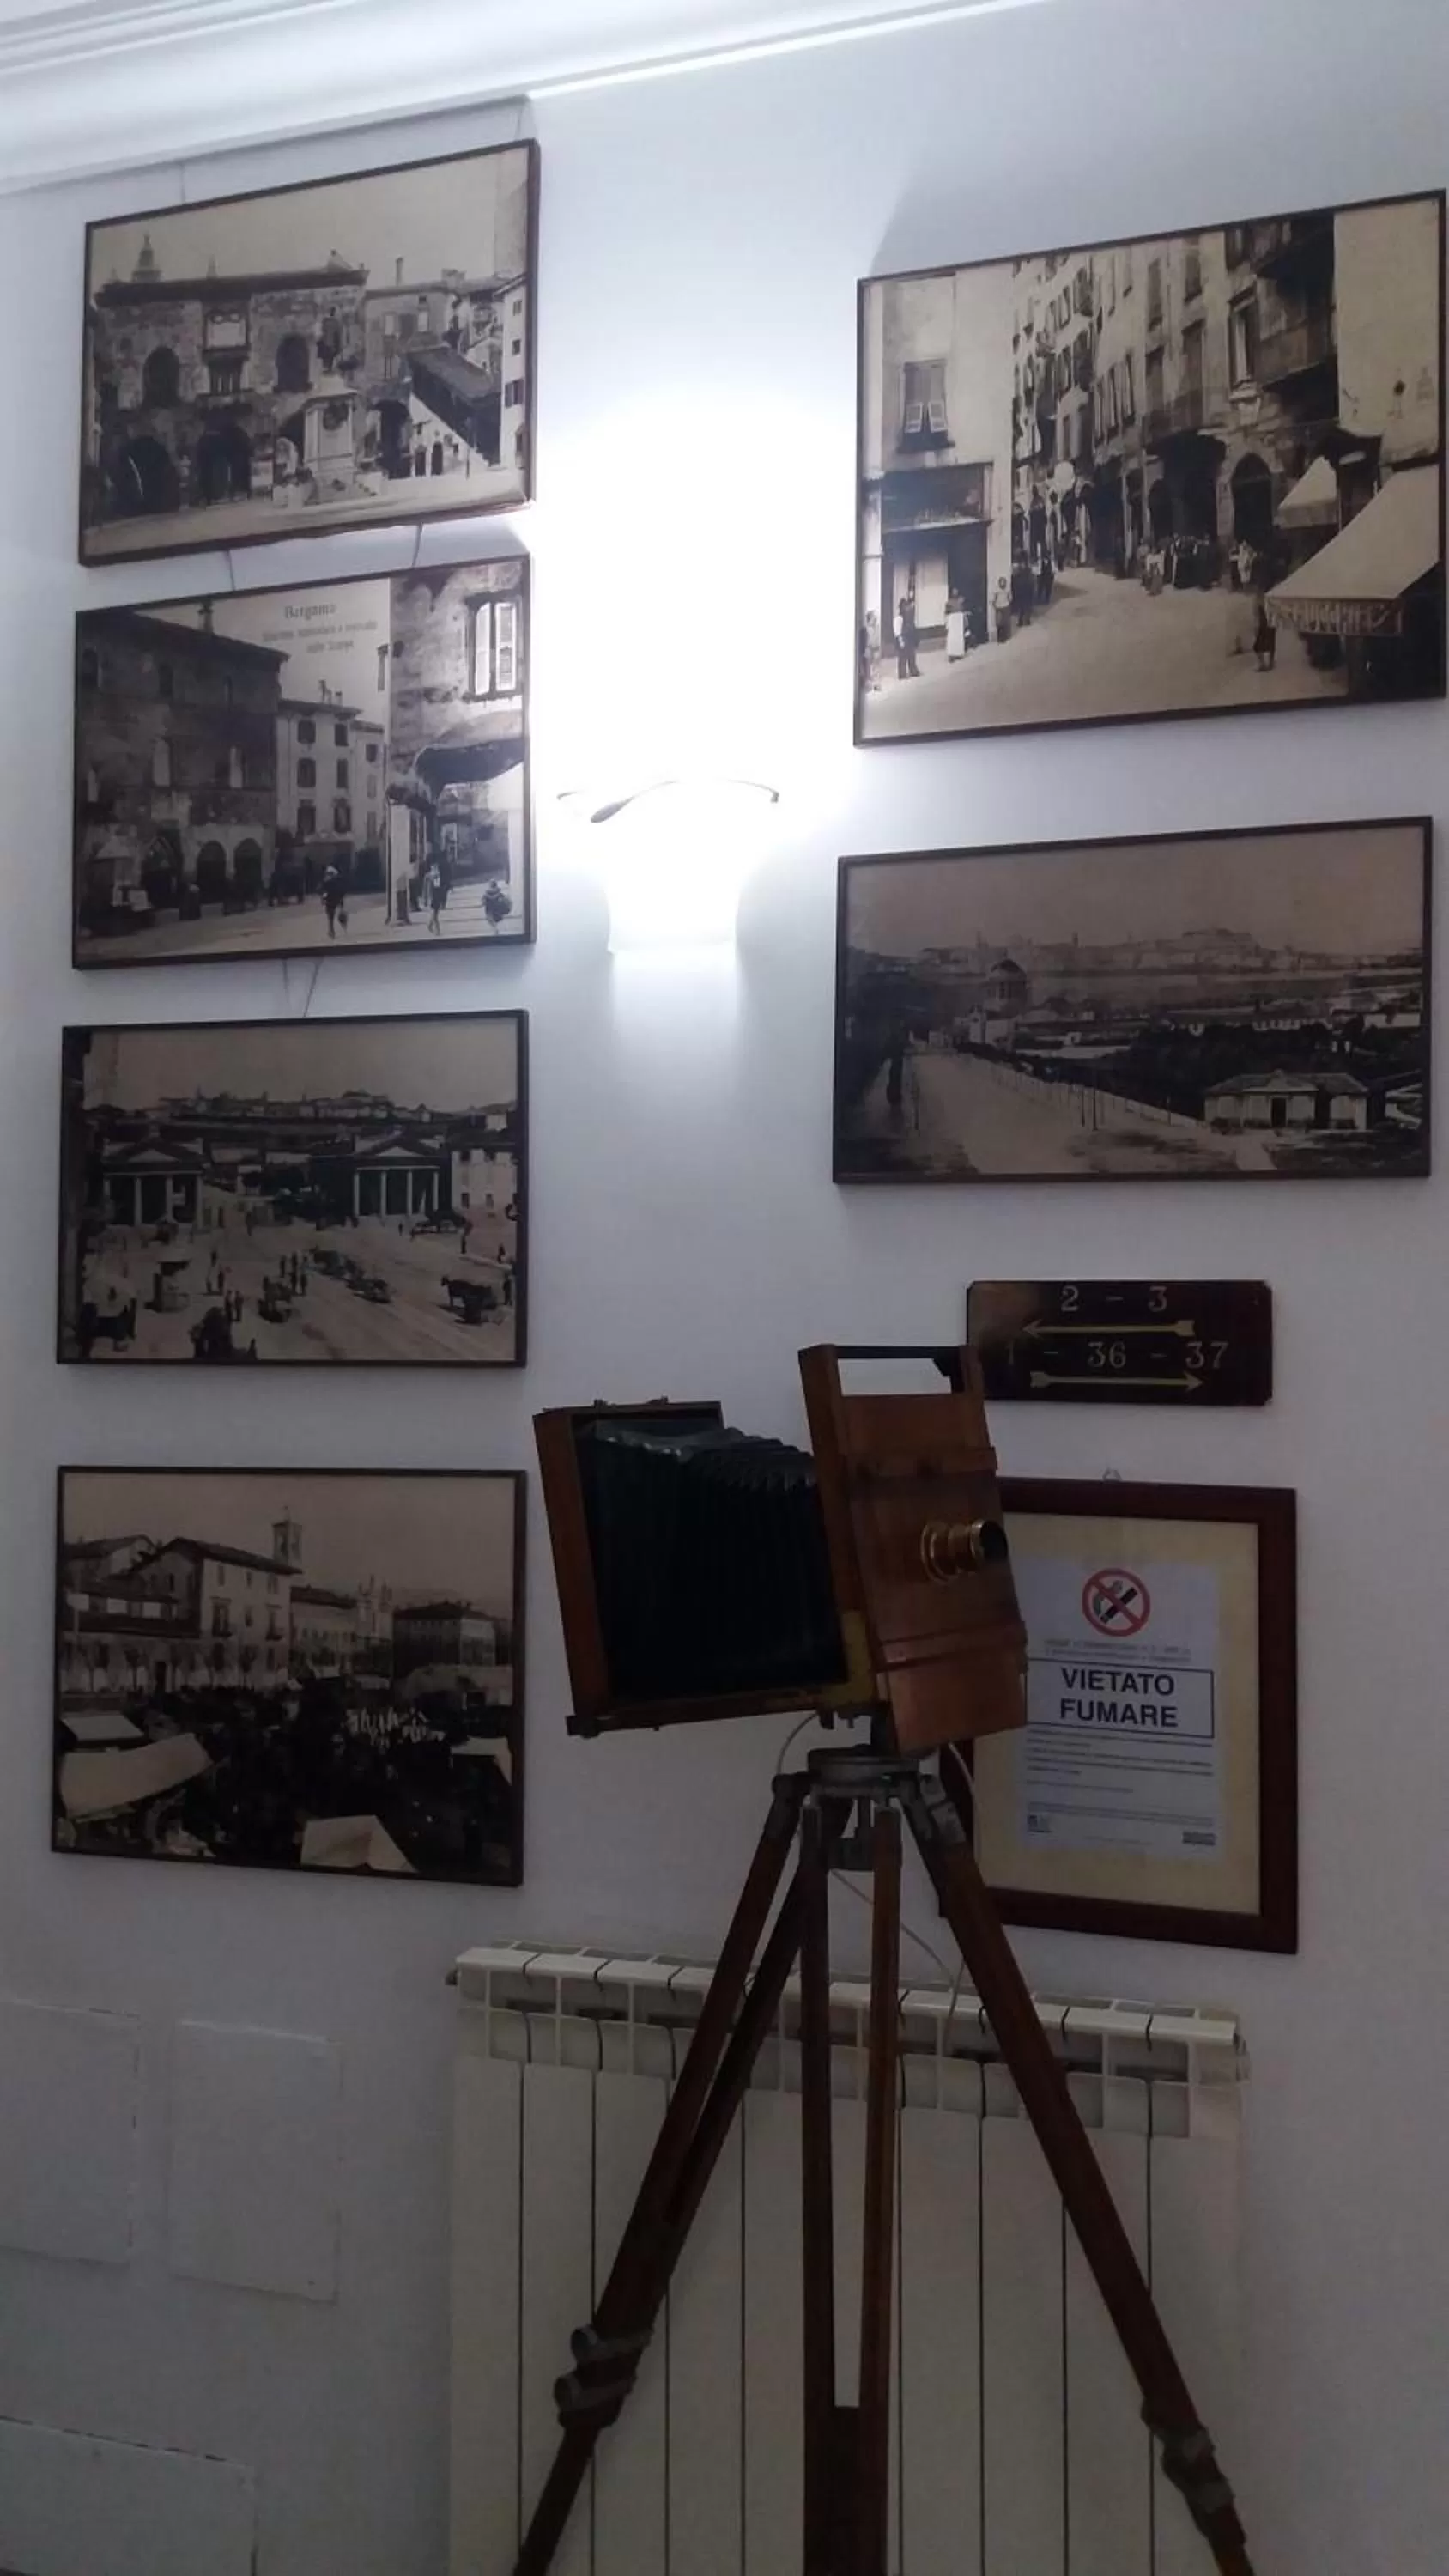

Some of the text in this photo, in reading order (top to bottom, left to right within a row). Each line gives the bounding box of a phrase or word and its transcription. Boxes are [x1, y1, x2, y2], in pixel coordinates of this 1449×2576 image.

[1061, 1285, 1079, 1312] 2
[1148, 1286, 1168, 1313] 3
[1087, 1341, 1126, 1368] 36
[1185, 1341, 1229, 1369] 37
[1060, 1667, 1175, 1697] VIETATO
[1059, 1698, 1179, 1728] FUMARE
